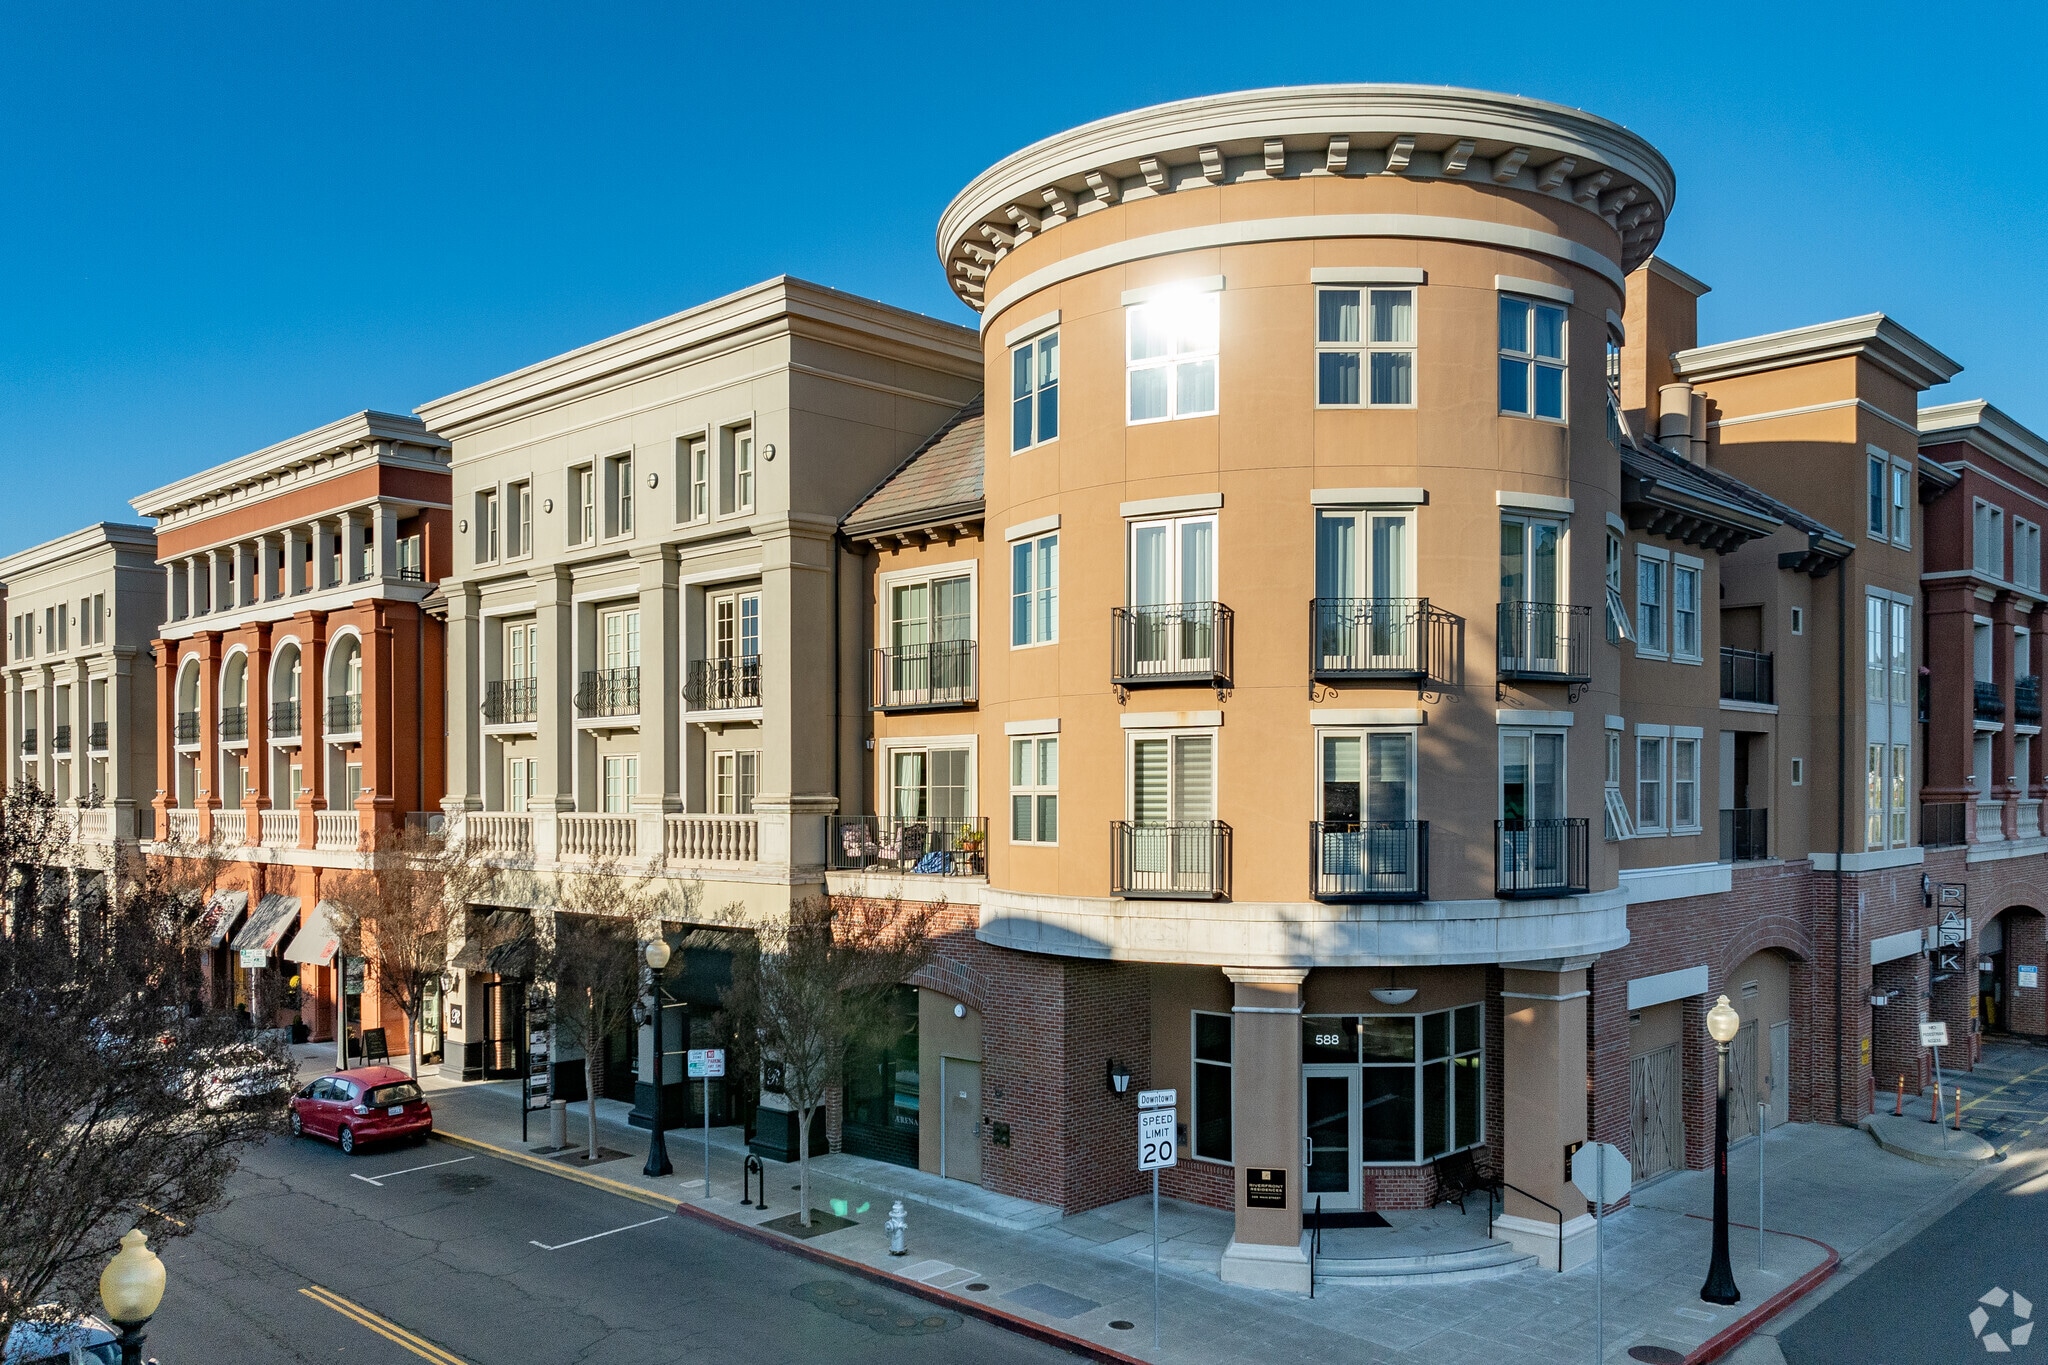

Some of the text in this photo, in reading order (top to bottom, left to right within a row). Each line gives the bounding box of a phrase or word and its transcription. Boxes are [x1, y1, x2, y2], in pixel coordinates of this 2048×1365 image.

[1941, 888, 1961, 970] PARK
[1315, 1034, 1339, 1045] 588
[1141, 1094, 1174, 1104] Downtown
[1142, 1115, 1173, 1126] SPEED
[1146, 1128, 1169, 1139] LIMIT
[1144, 1141, 1172, 1163] 20
